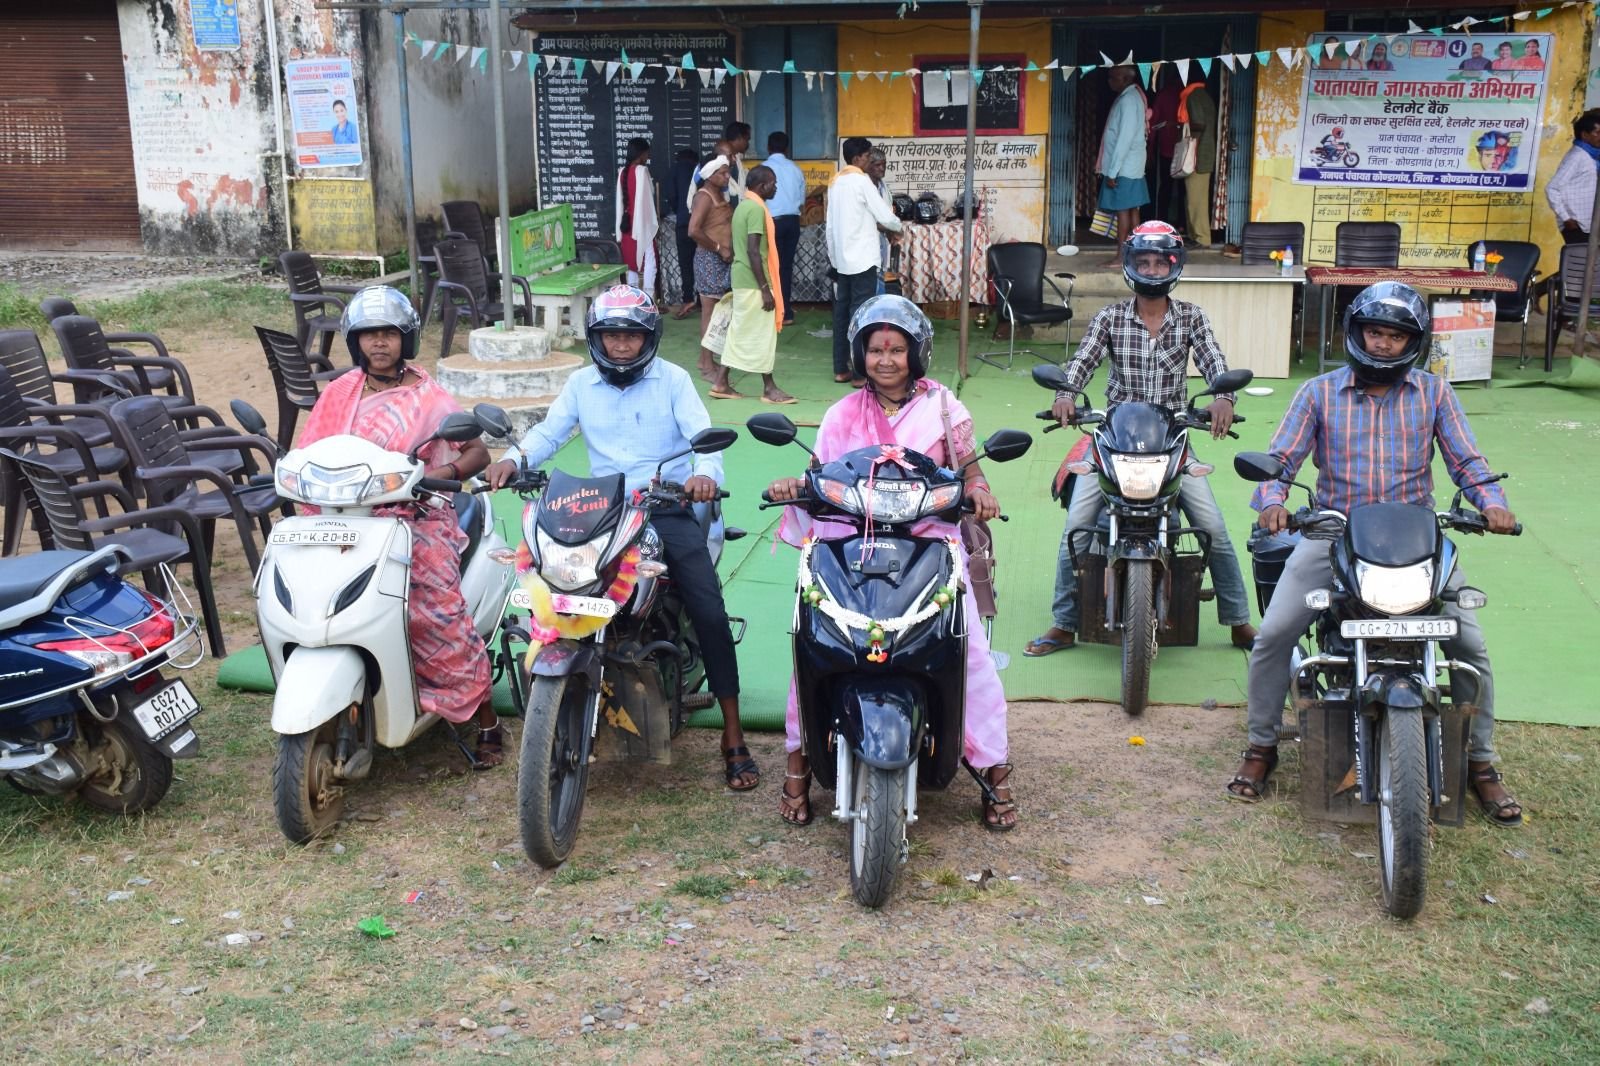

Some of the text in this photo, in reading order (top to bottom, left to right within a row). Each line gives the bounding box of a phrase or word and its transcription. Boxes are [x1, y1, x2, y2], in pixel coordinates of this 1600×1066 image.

[1314, 79, 1378, 97] यातायात
[1469, 78, 1536, 99] अभियान
[1384, 99, 1449, 114] हेलमेट बैंक
[1350, 116, 1361, 125] का
[1363, 117, 1386, 126] सफर
[1389, 115, 1422, 129] सुरक्षित
[1446, 117, 1476, 128] हेलमेट
[1378, 134, 1394, 142] ग्राम
[1002, 142, 1037, 158] मंगलवार
[1367, 146, 1391, 154] जनपद
[1368, 156, 1388, 165] जिला
[1320, 171, 1343, 180] जनपद
[1412, 173, 1433, 183] जिला
[586, 602, 609, 613] 1475
[151, 686, 178, 711] CG27
